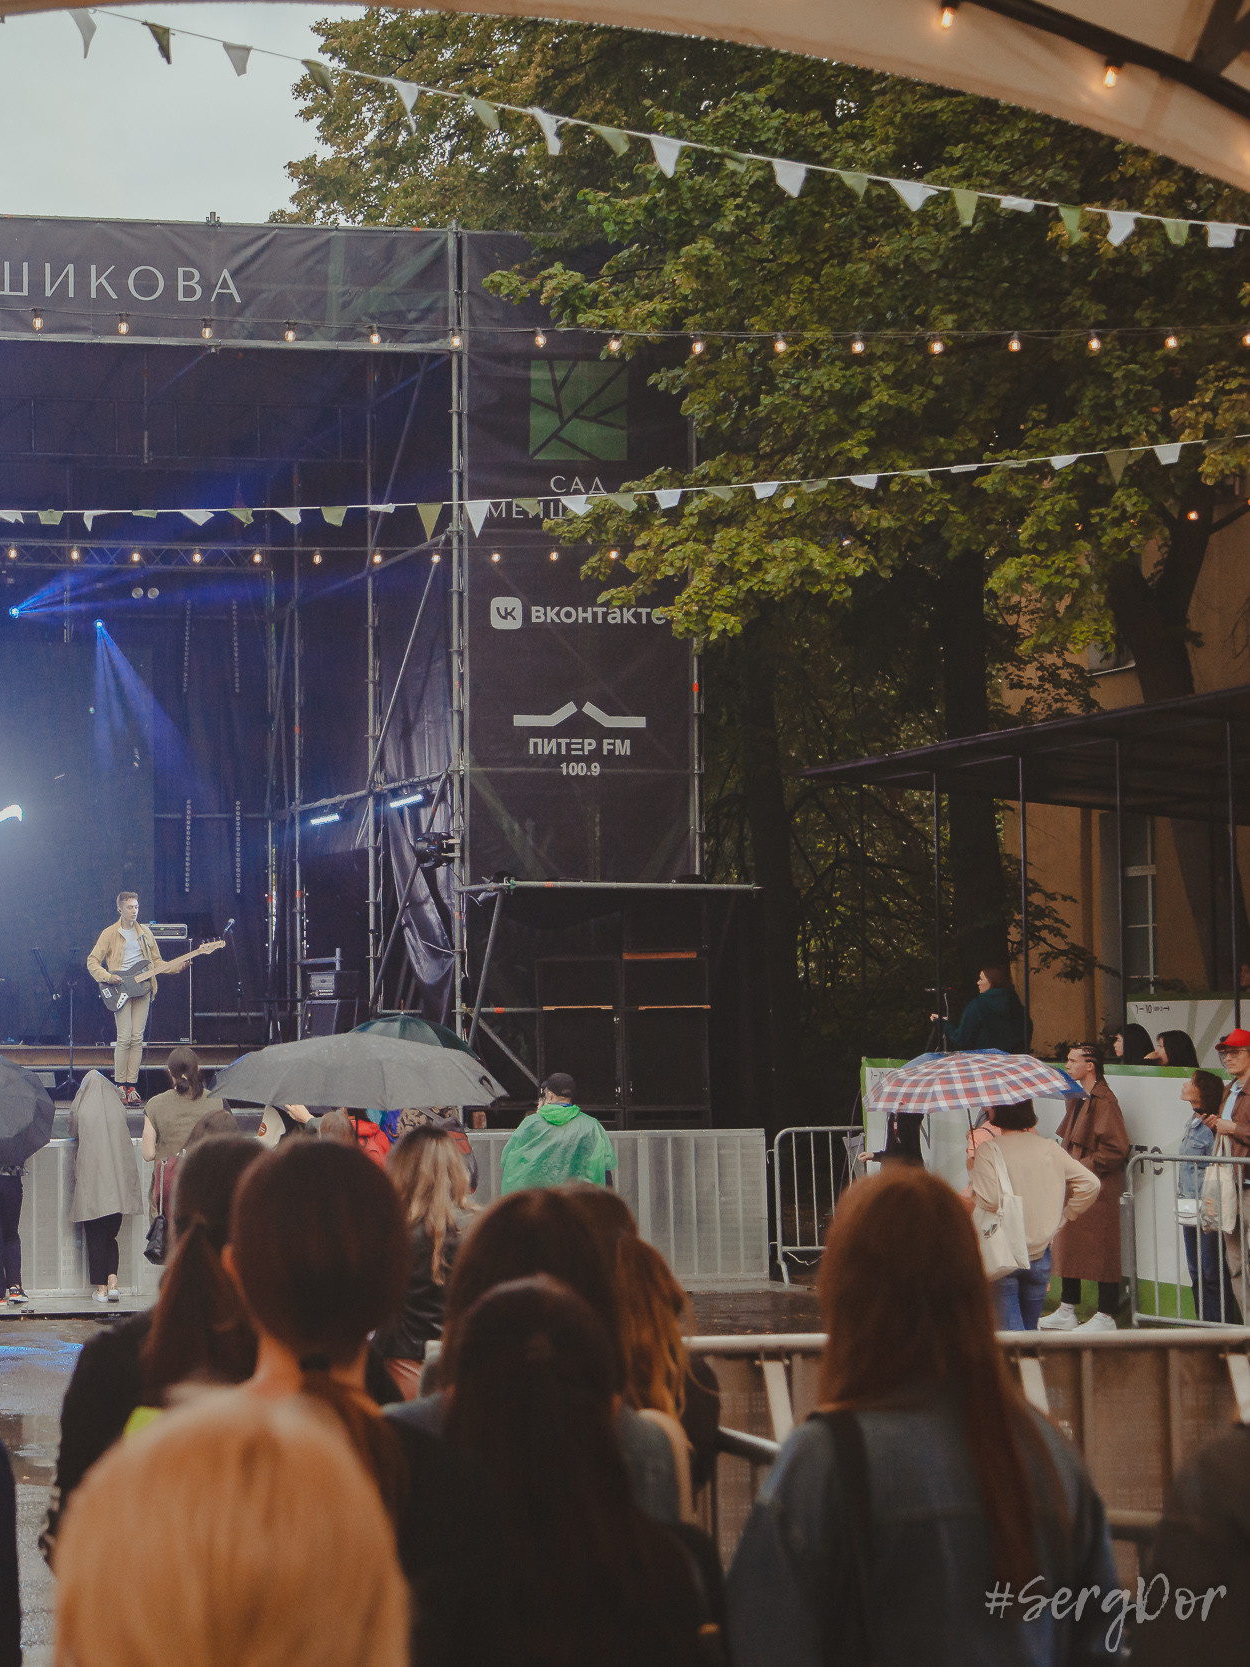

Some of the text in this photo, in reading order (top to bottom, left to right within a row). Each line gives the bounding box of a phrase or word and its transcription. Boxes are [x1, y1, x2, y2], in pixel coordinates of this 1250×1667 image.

[550, 476, 608, 494] САД
[529, 738, 631, 755] ПИТЕР FM
[560, 762, 601, 775] 100.9
